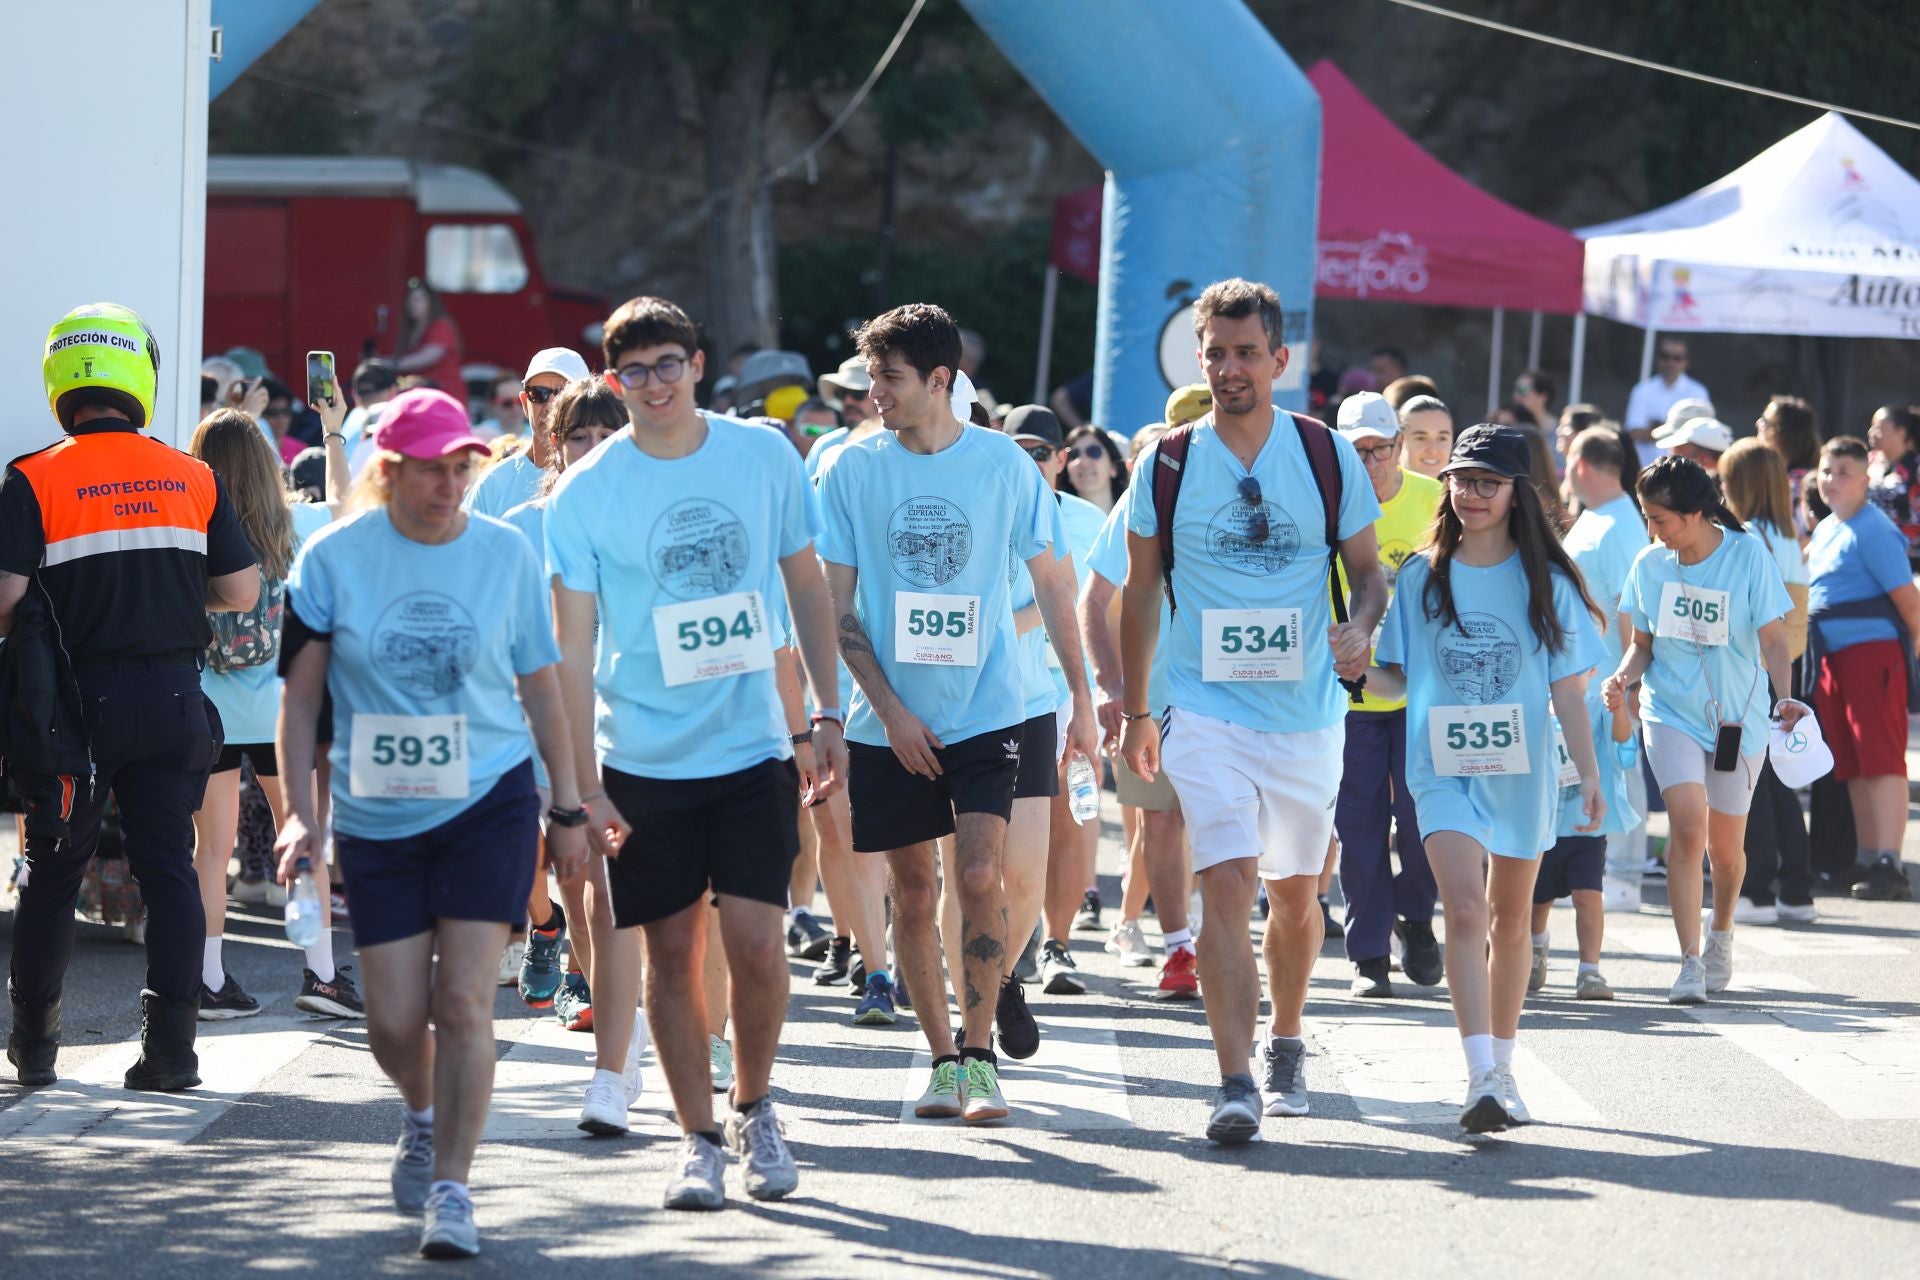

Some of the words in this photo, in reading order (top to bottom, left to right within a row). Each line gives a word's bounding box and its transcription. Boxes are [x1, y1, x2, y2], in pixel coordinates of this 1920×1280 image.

[49, 331, 108, 354] PROTECCIÓN
[111, 336, 137, 352] CIVIL
[76, 477, 186, 500] PROTECCIÓN
[113, 501, 159, 516] CIVIL
[908, 608, 966, 638] 595
[967, 600, 976, 634] MARCHA
[1673, 595, 1719, 623] 505
[677, 609, 754, 651] 594
[1220, 624, 1290, 653] 534
[915, 652, 953, 660] CIPRIANO
[1447, 721, 1512, 750] 535
[1512, 708, 1521, 743] MARCHA
[372, 734, 452, 767] 593
[312, 981, 337, 998] HOKA
